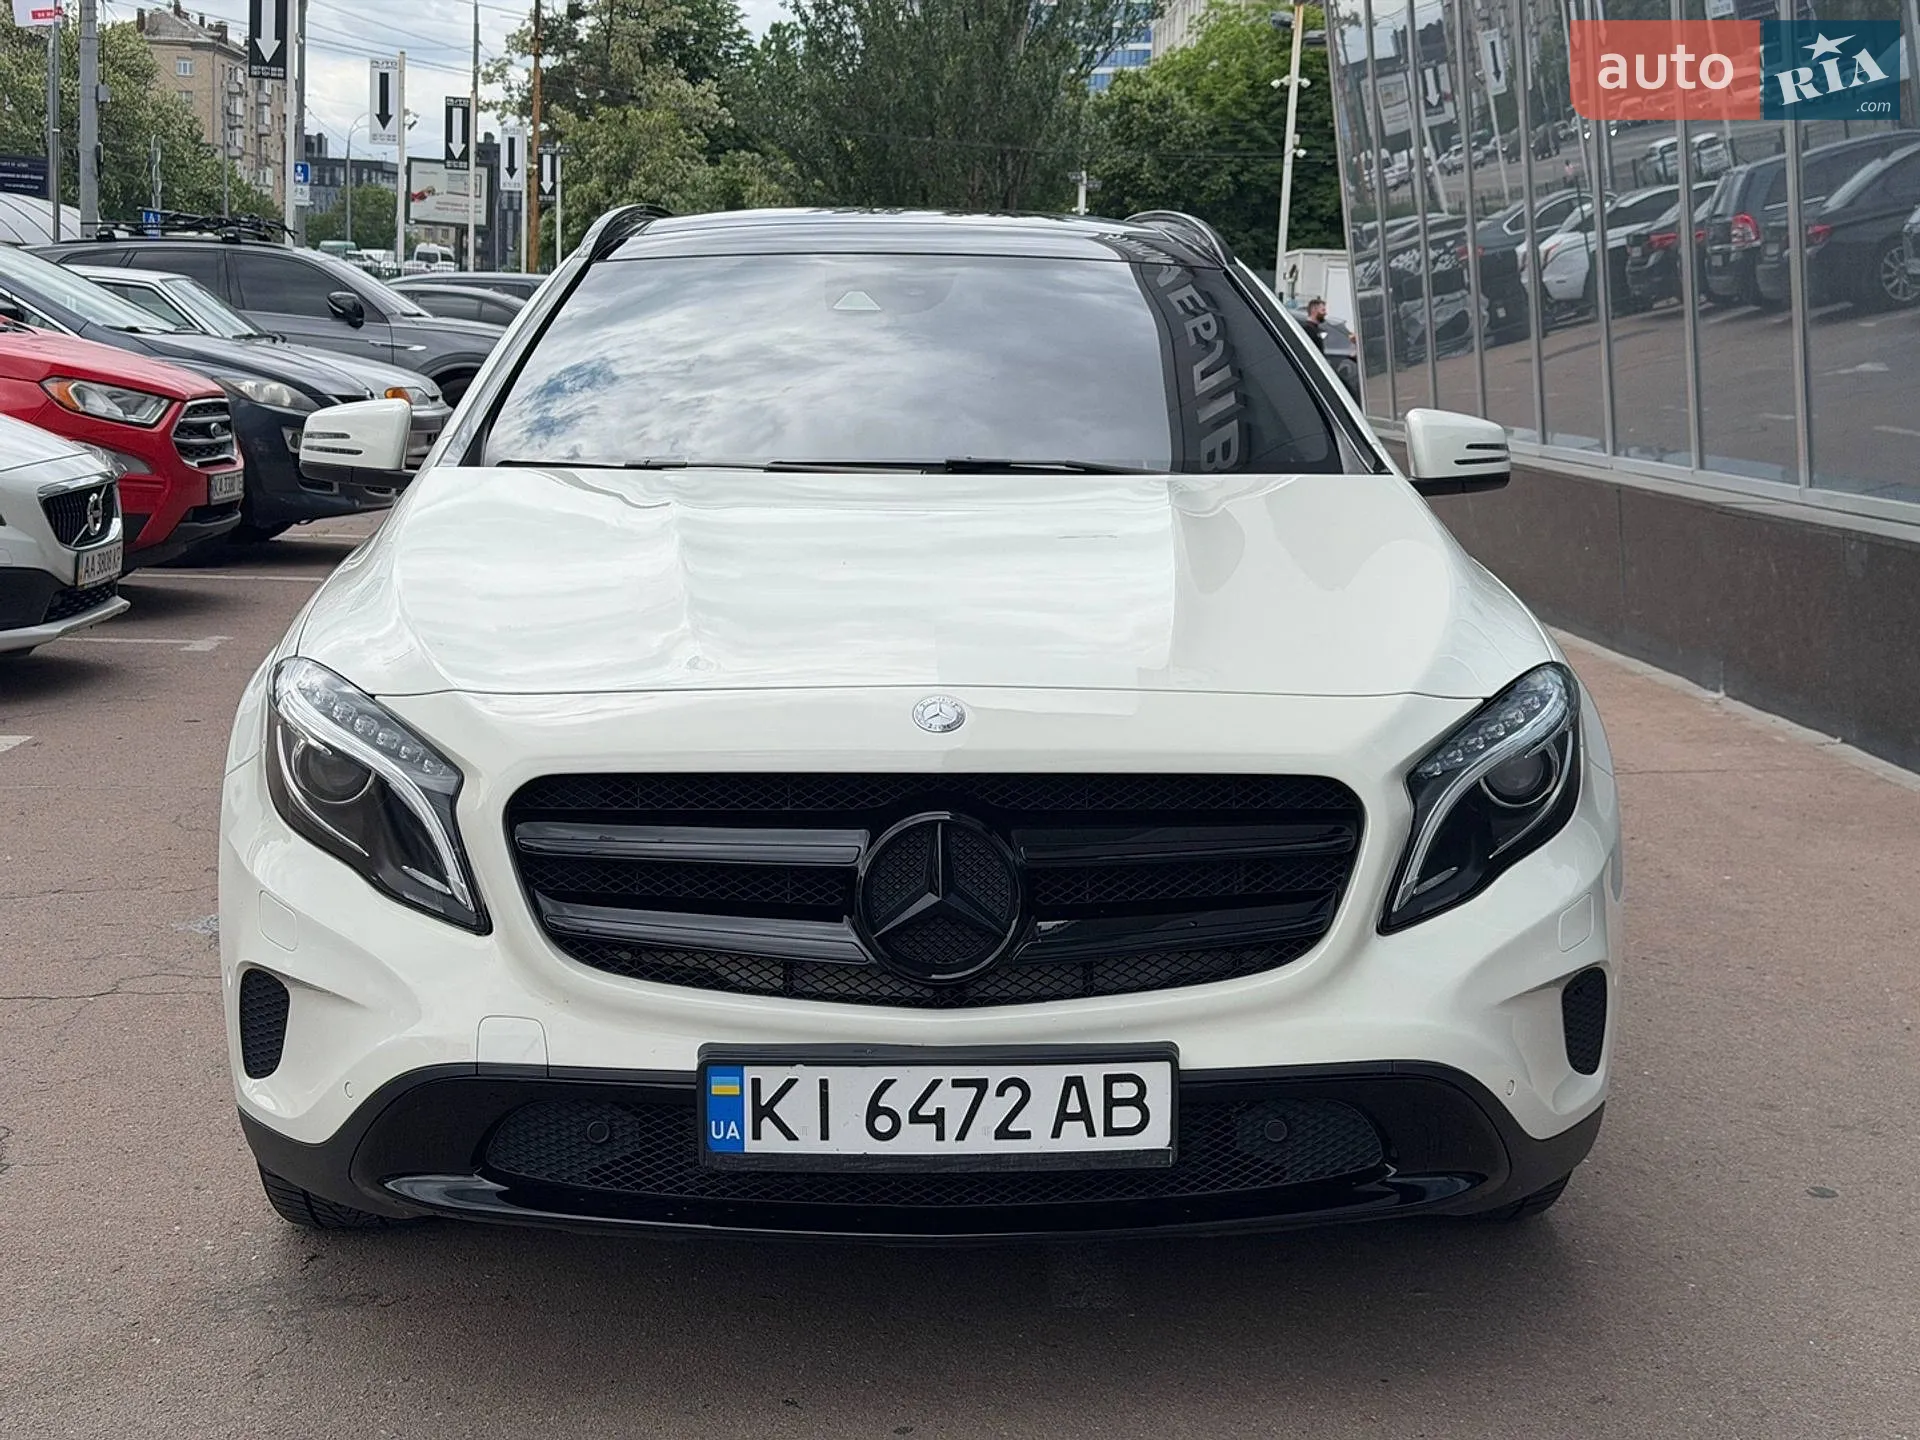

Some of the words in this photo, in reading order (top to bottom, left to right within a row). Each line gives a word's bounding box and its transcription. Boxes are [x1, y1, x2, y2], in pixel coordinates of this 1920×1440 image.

[751, 1077, 830, 1142] KI
[865, 1077, 1032, 1142] 6472
[1050, 1072, 1151, 1140] AB
[711, 1121, 740, 1140] UA
